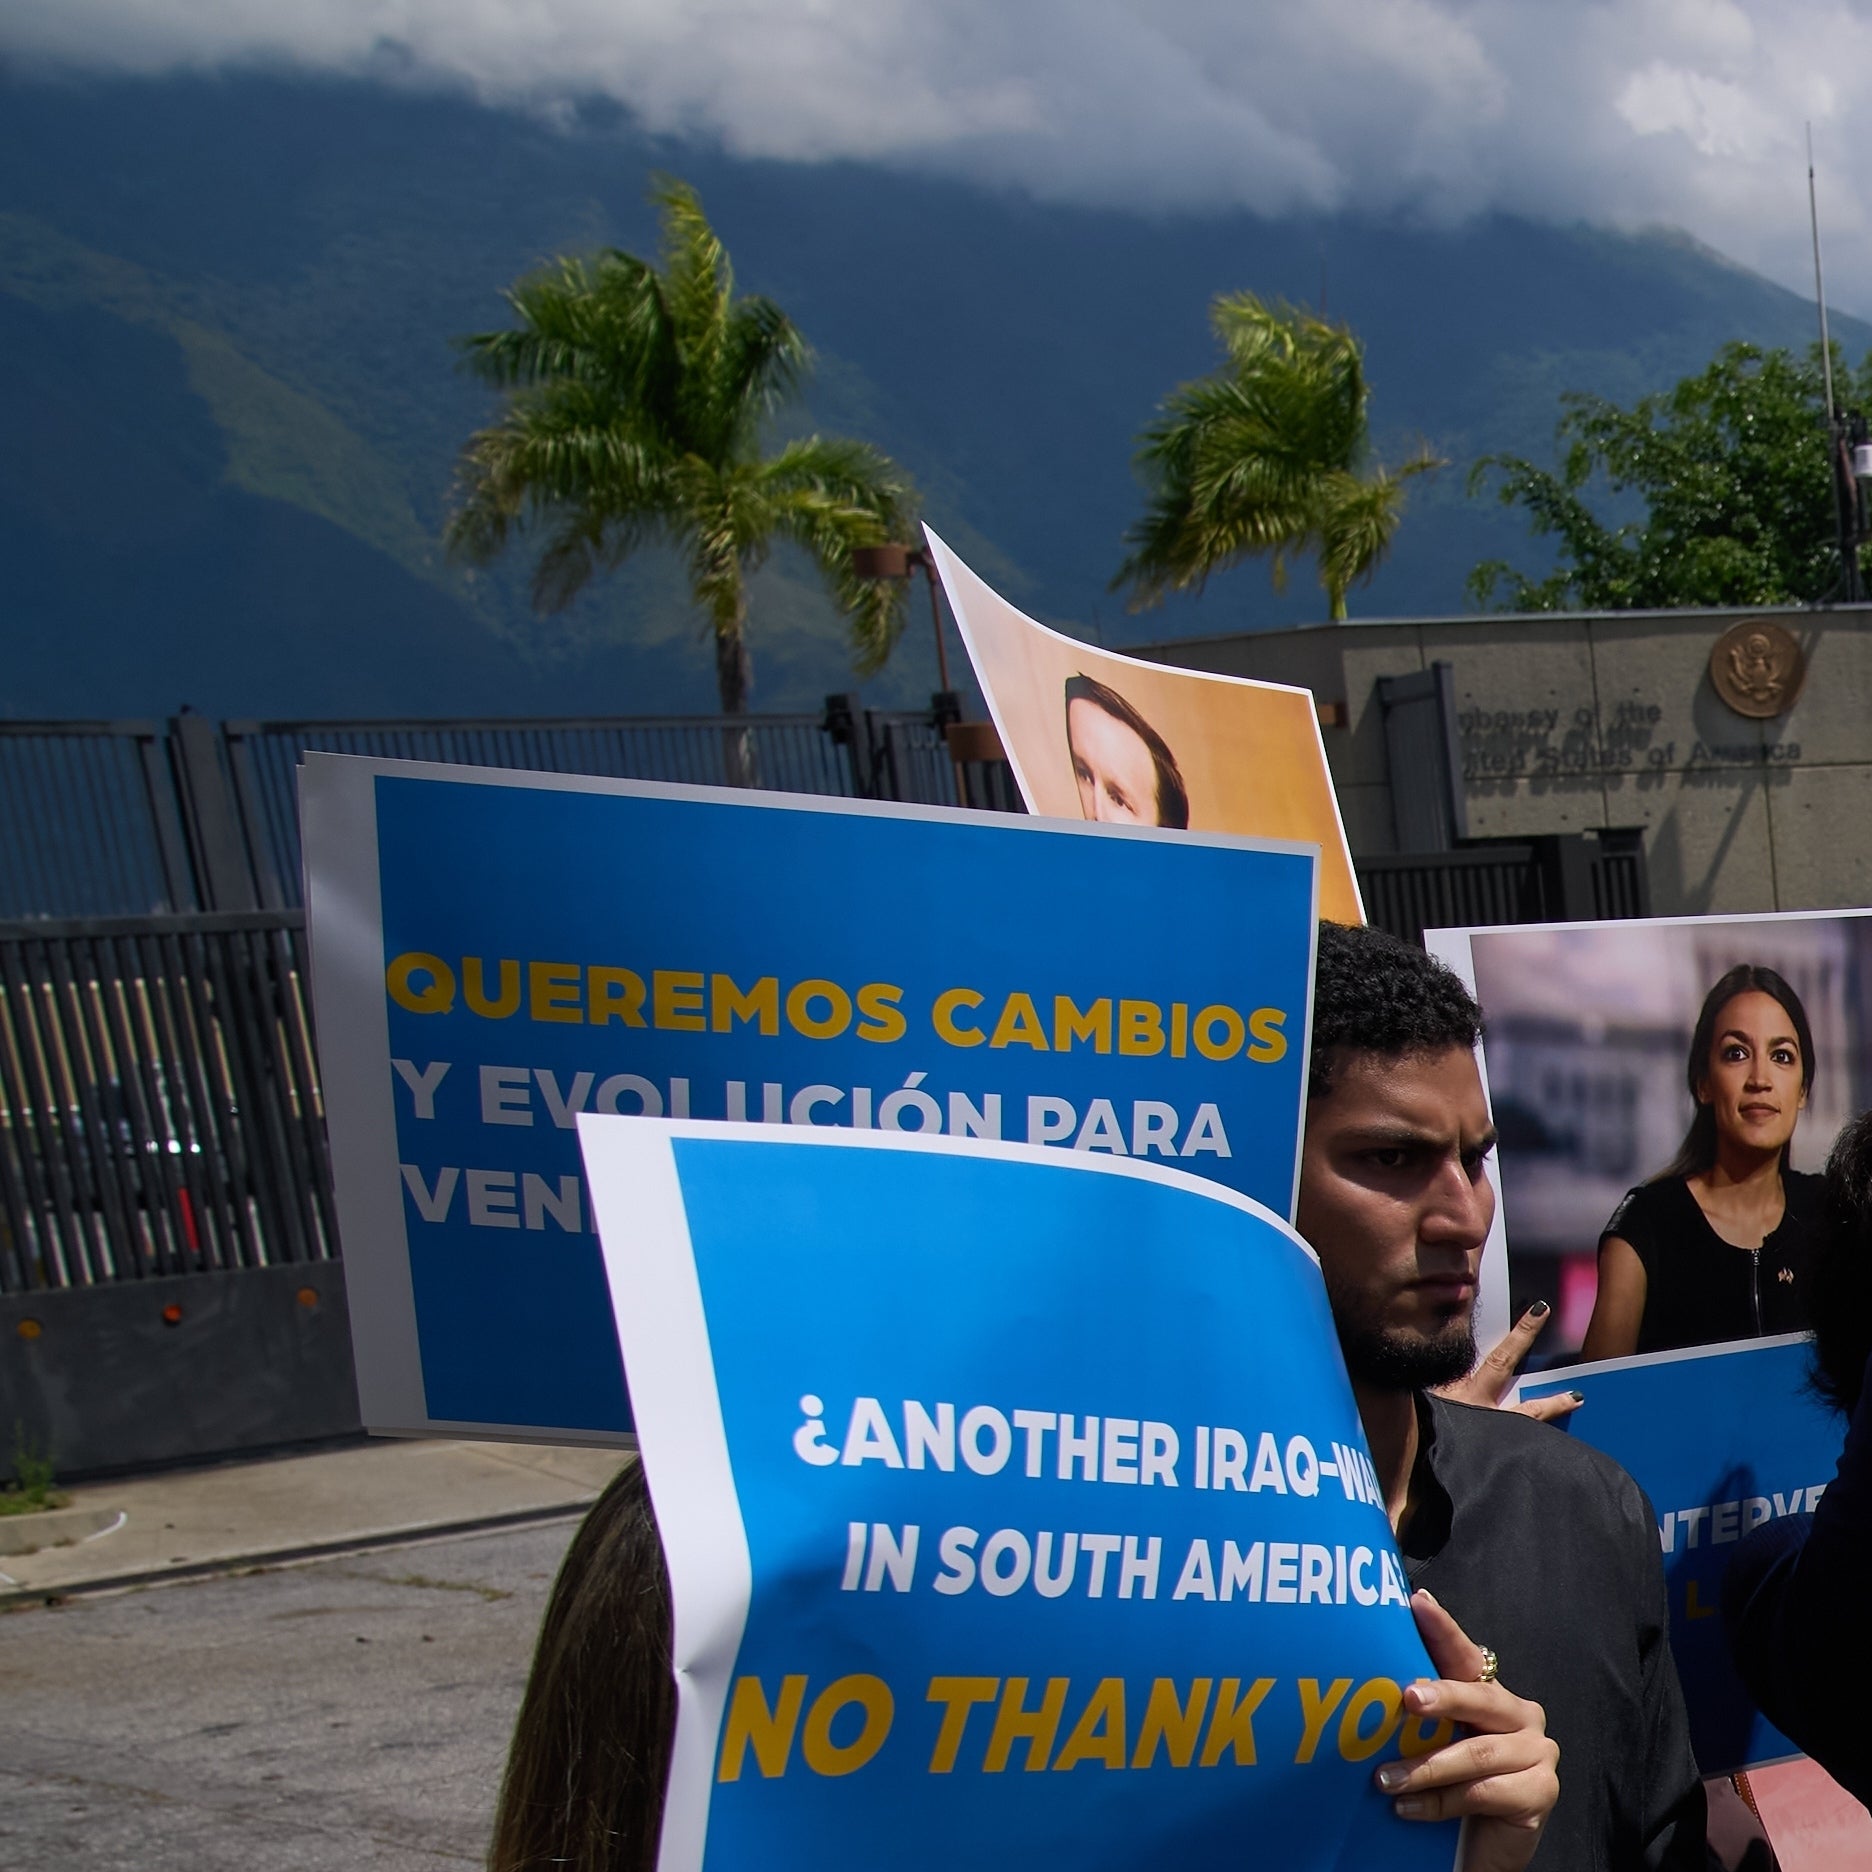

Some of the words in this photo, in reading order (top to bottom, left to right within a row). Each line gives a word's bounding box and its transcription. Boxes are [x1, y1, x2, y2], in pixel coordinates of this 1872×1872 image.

[386, 950, 906, 1042] QUEREMOS
[932, 988, 1288, 1063] CAMBIOS
[391, 1058, 451, 1120] Y
[1028, 1095, 1231, 1159] PARA
[399, 1163, 599, 1233] VEN
[794, 1394, 1178, 1488] ¿ANOTHER
[1195, 1425, 1387, 1516] IRAQ-WA
[840, 1522, 919, 1592] IN
[932, 1528, 1162, 1600] SOUTH
[718, 1673, 894, 1783] NO
[925, 1676, 1274, 1774] THANK
